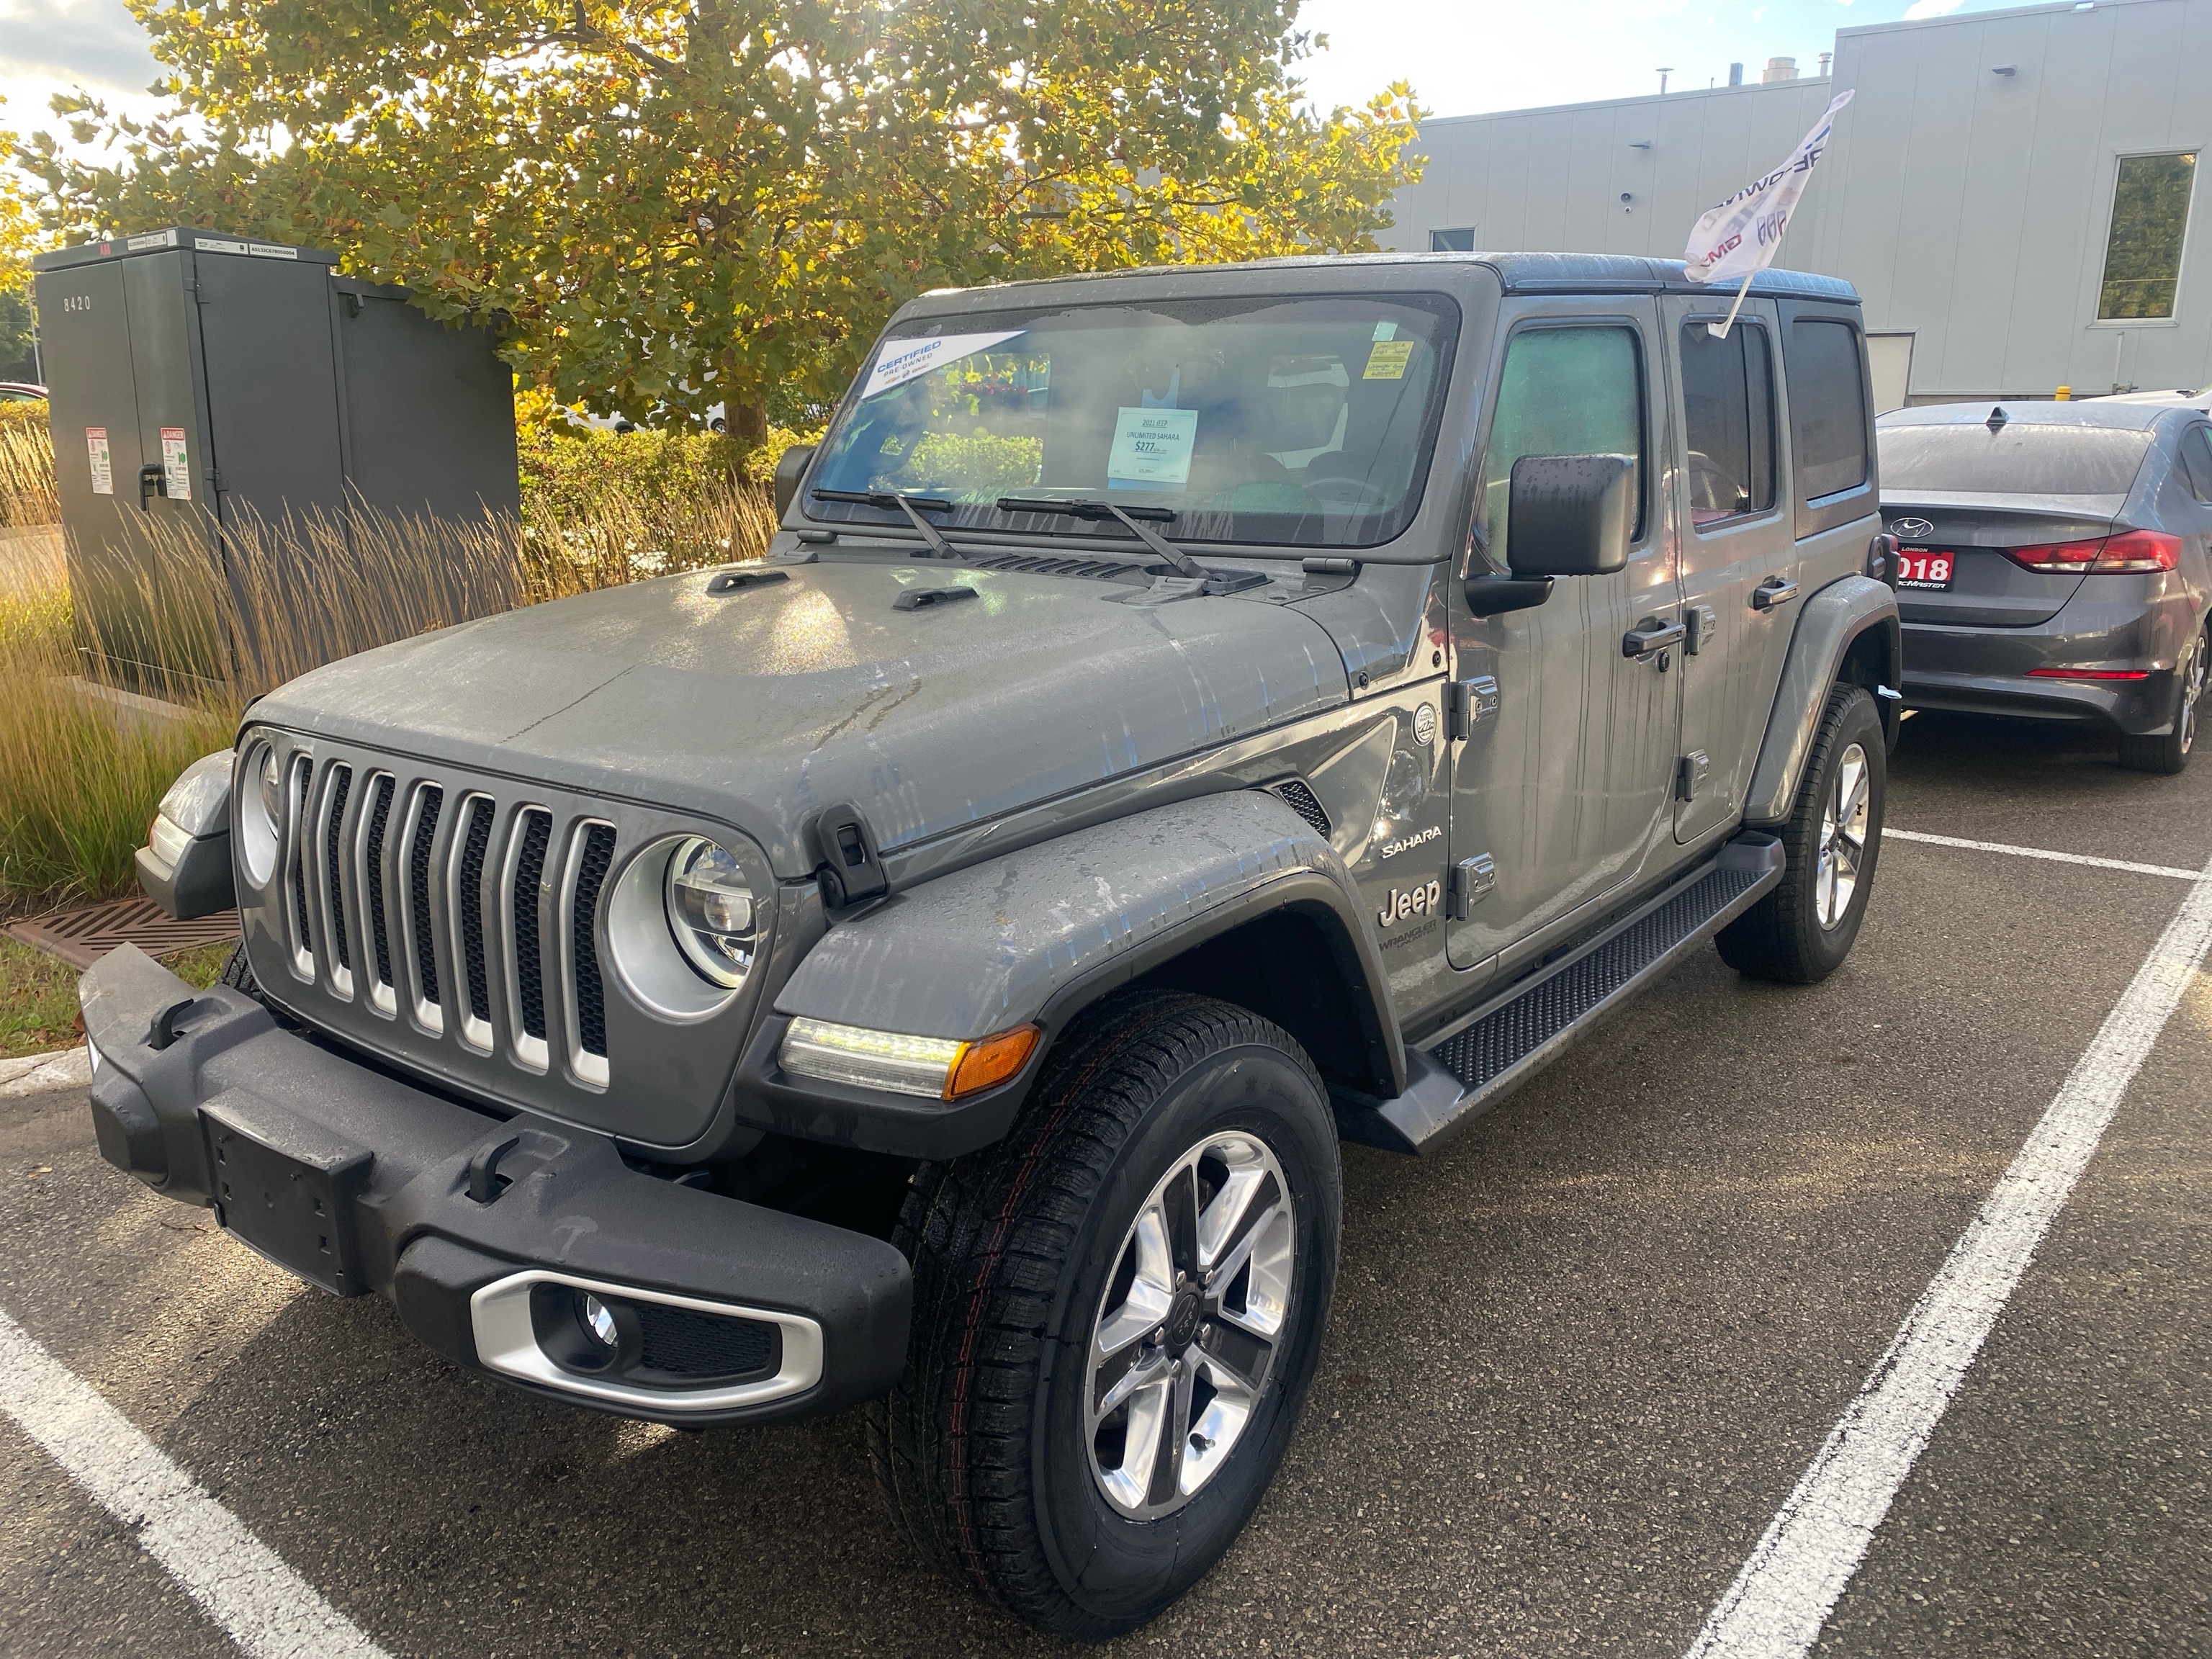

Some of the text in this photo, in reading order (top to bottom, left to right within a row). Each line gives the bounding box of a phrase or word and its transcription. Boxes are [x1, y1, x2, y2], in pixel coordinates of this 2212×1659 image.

[63, 295, 91, 313] 8420
[877, 340, 942, 374] CERTIFIED
[884, 352, 932, 377] PRE-OWNED
[912, 362, 930, 373] GMC
[166, 430, 184, 439] DANGER
[1126, 431, 1179, 441] UNLIMITED SAHARA
[1135, 440, 1155, 452] $277
[1380, 825, 1442, 860] SAHARA
[1378, 880, 1440, 927] Jeep
[1379, 919, 1437, 952] WRANGLER
[1397, 927, 1437, 948] UNLIMITED
